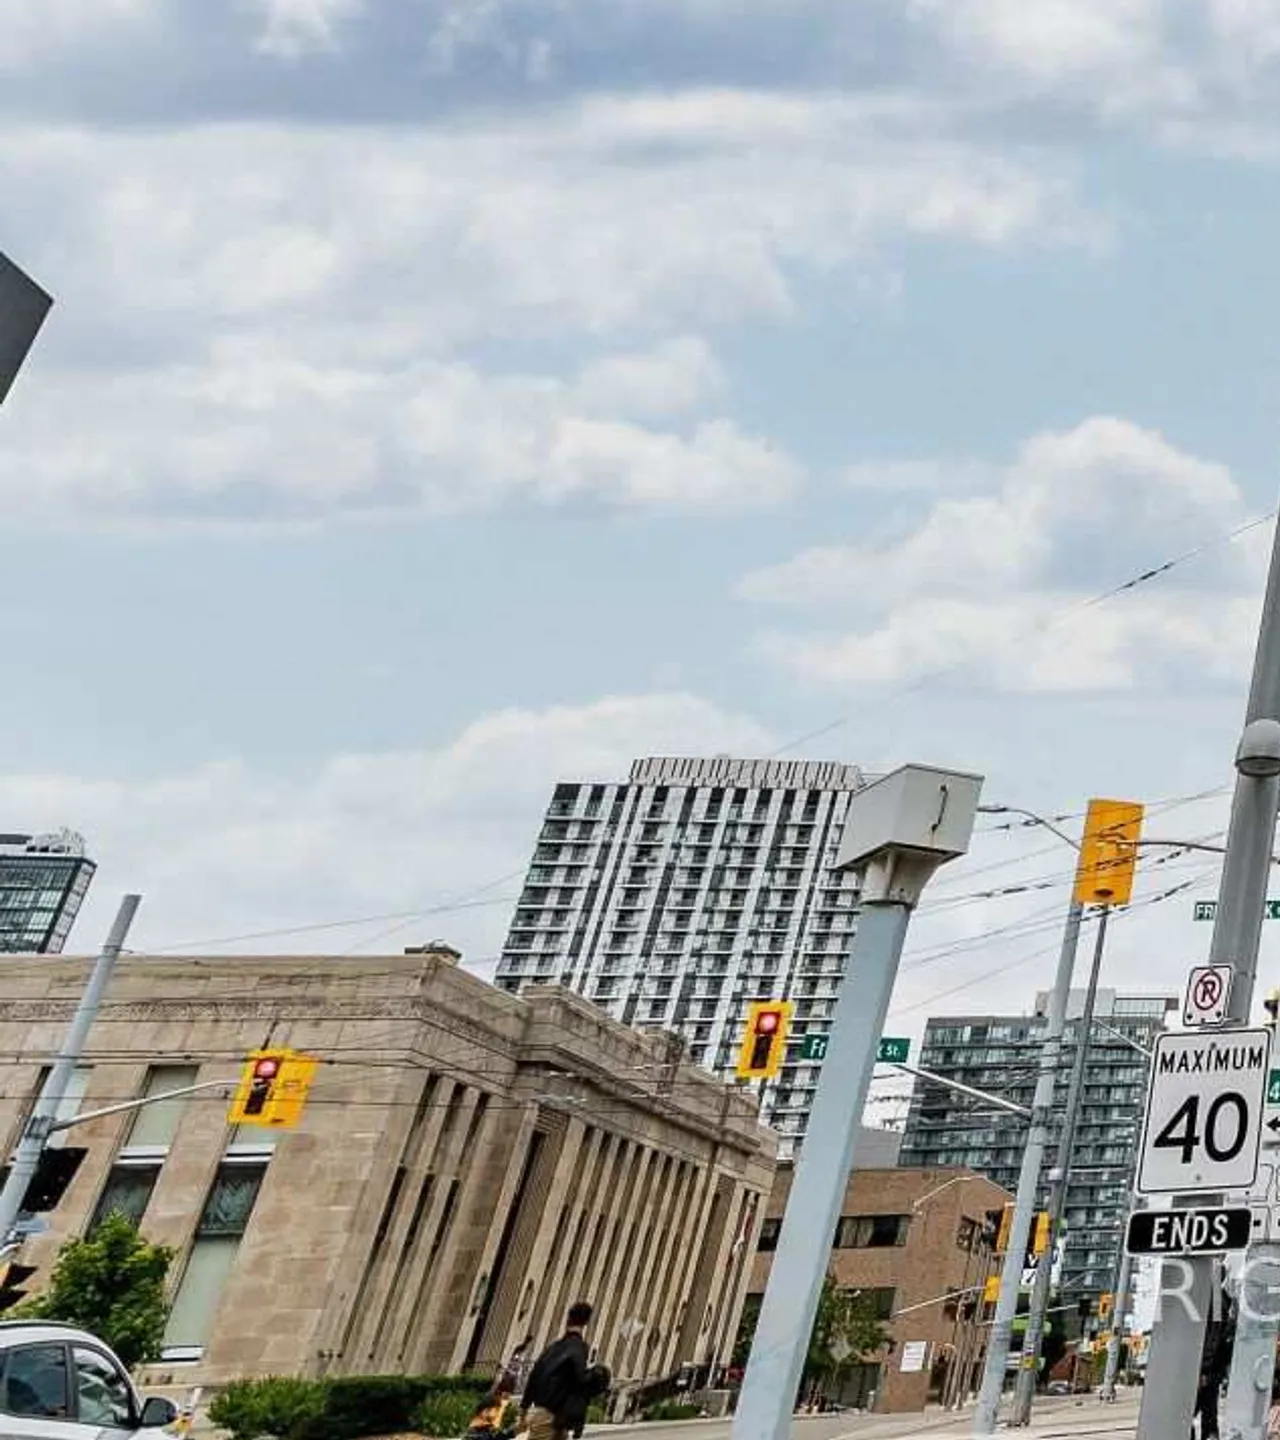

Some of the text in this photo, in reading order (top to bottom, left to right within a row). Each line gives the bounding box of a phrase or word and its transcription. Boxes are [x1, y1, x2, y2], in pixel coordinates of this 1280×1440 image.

[1160, 1046, 1263, 1074] MAXIMUM
[1153, 1091, 1248, 1164] 40
[1152, 1213, 1229, 1249] ENDS
